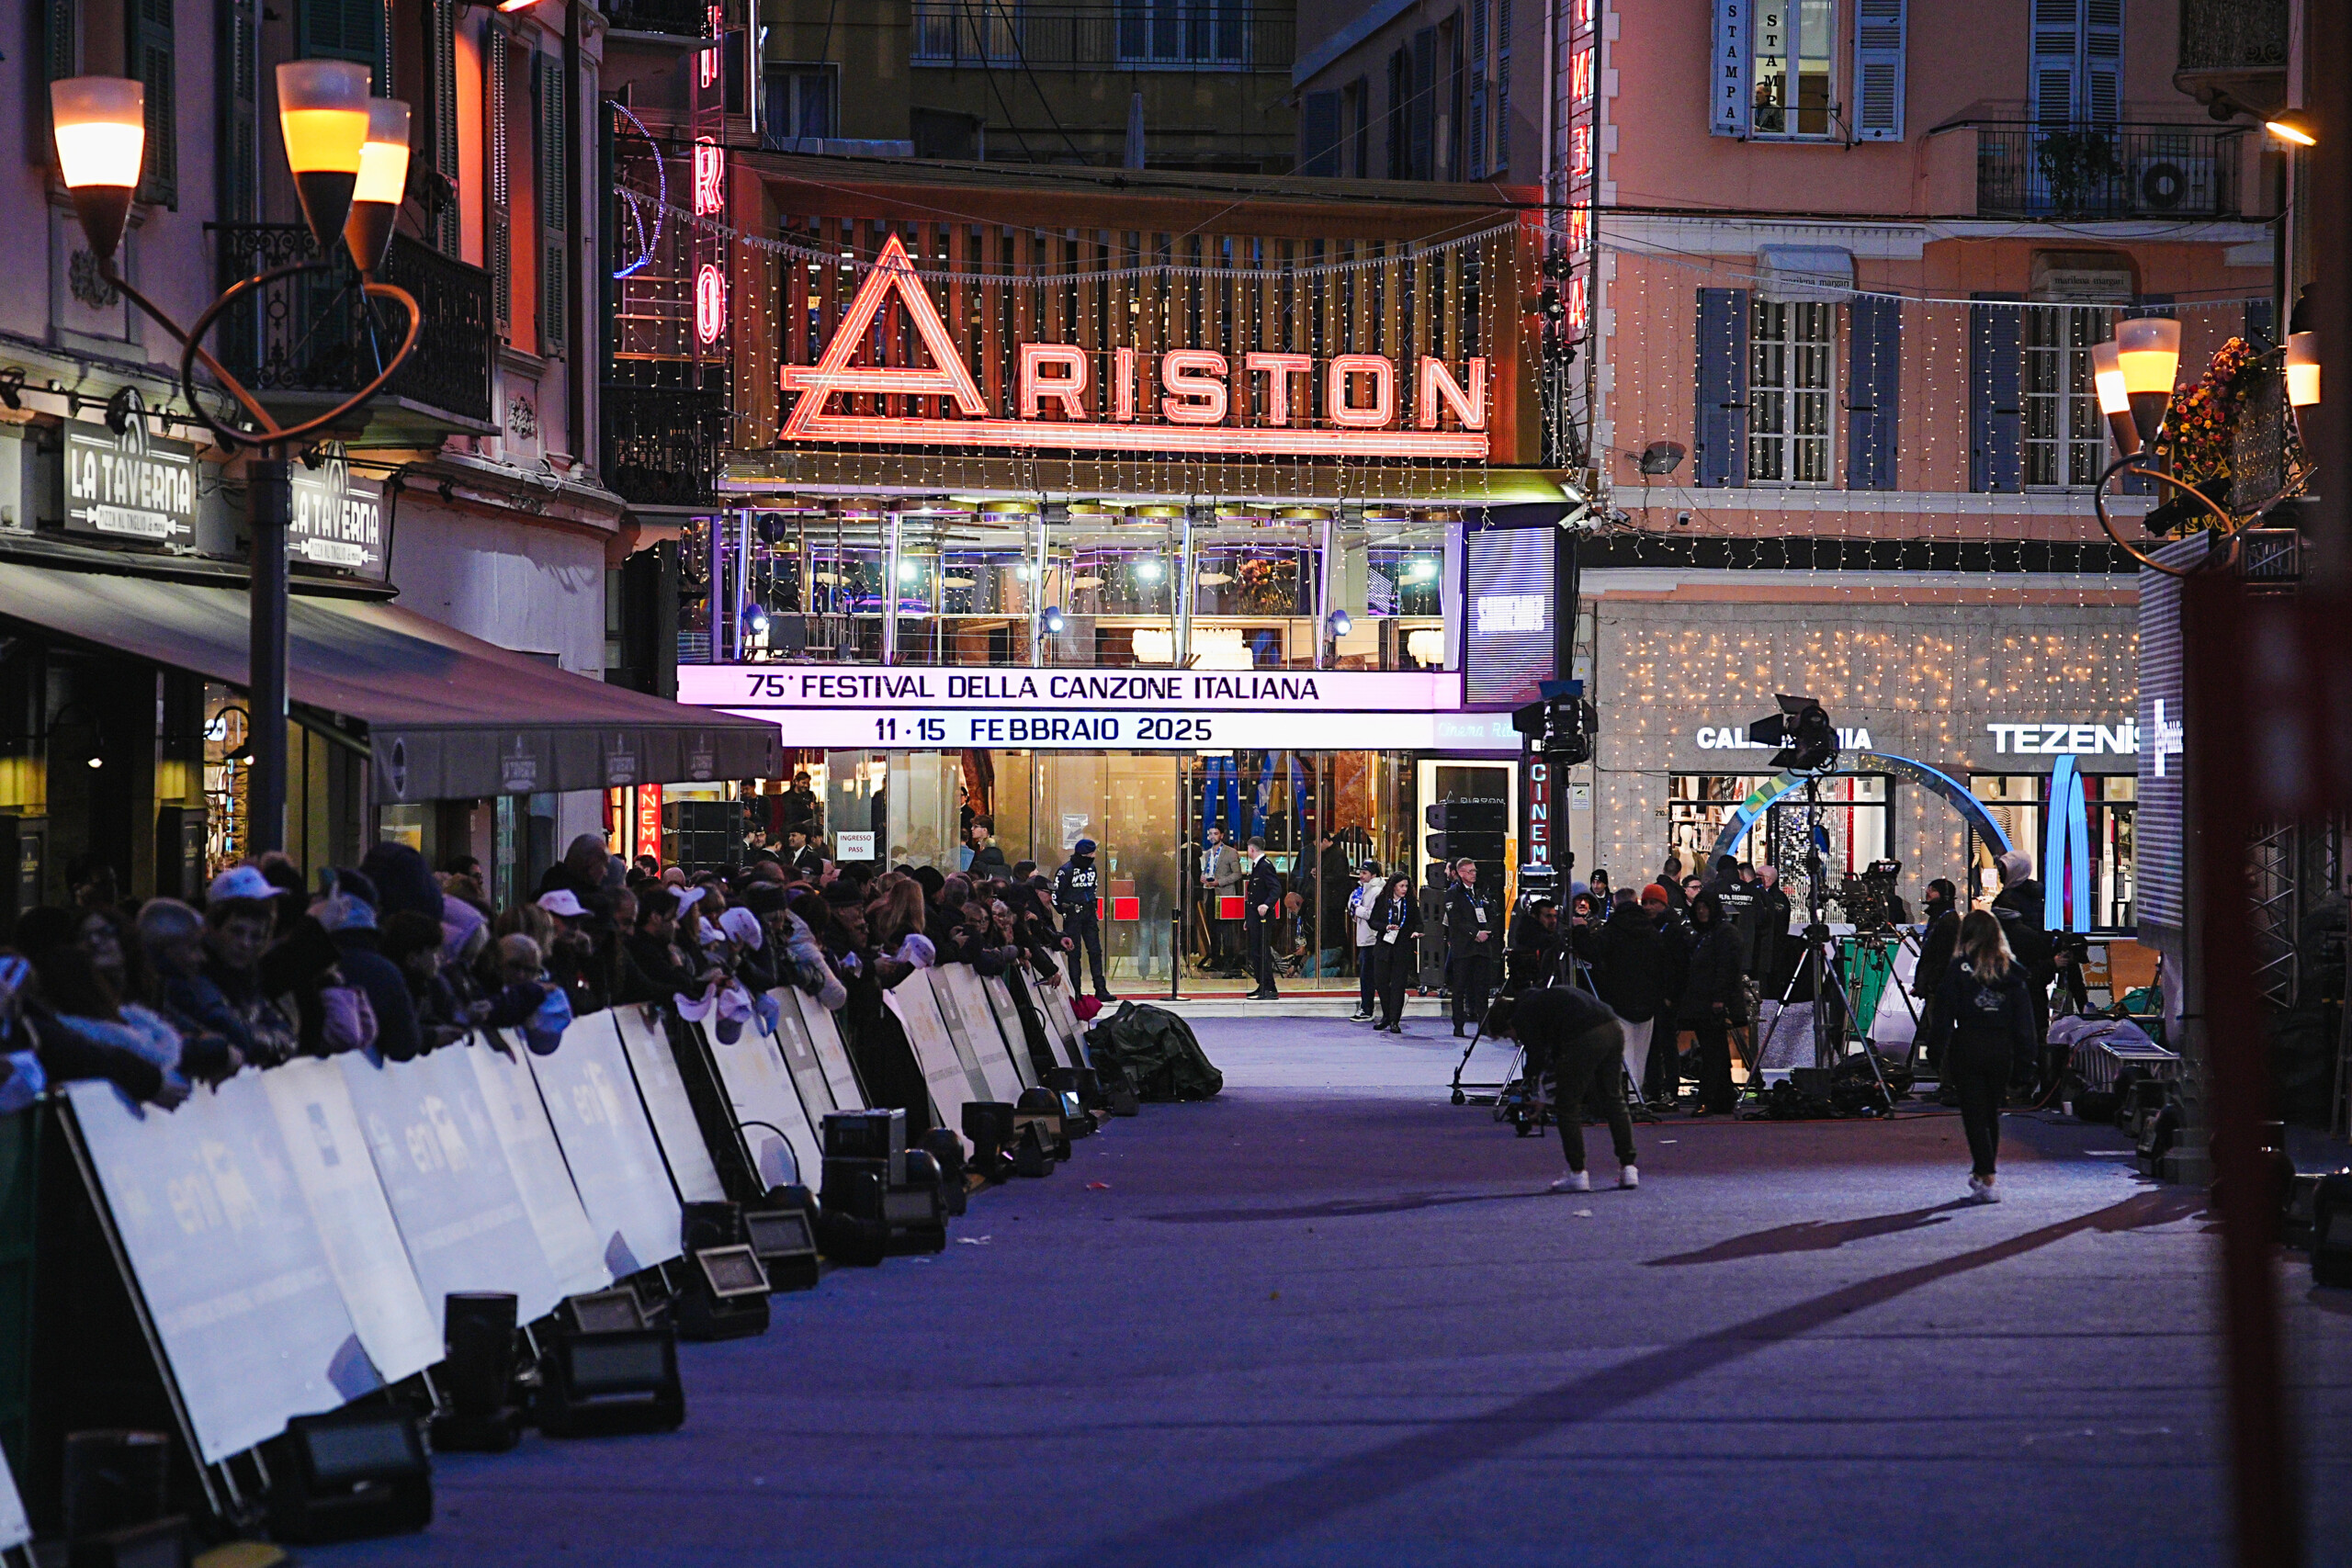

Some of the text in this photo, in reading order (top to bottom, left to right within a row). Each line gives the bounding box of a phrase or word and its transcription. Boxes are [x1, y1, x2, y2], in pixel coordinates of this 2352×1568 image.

[1725, 5, 1737, 118] STAMPA
[1764, 14, 1779, 127] STAMPA
[2054, 276, 2124, 287] marilena margari
[779, 231, 1489, 458] ARISTON
[71, 448, 191, 514] LA TAVERNA
[289, 491, 379, 545] A TAVERNA
[802, 675, 935, 698] FESTIVAL
[948, 675, 1038, 698] DELLA
[1050, 676, 1182, 699] CANZONE
[1194, 677, 1319, 700] ITALIANA
[970, 718, 1119, 741] FEBBRAIO
[1136, 717, 1212, 741] 2025
[1438, 722, 1485, 738] Cinema
